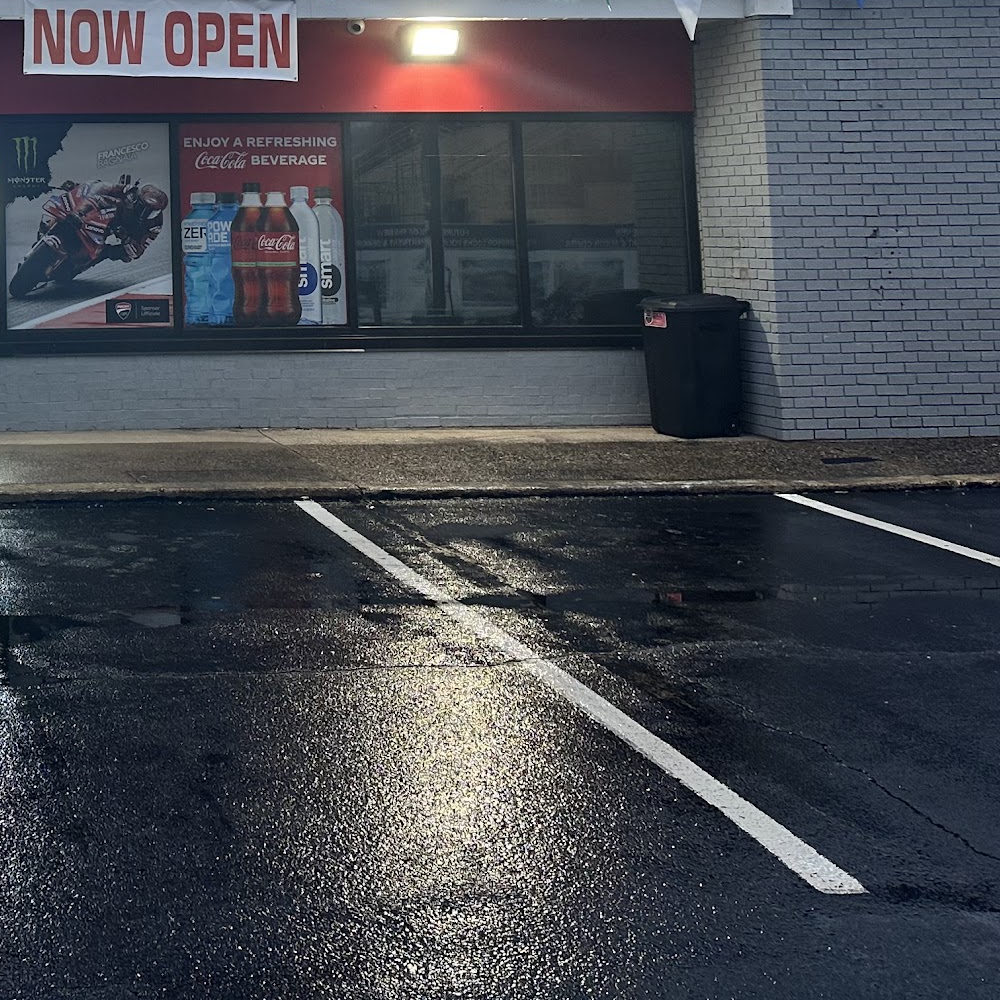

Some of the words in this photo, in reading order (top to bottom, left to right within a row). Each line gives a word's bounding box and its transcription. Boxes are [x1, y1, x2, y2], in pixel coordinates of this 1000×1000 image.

[33, 8, 146, 66] NOW
[164, 10, 291, 69] OPEN
[183, 137, 230, 148] ENJOY
[232, 137, 243, 147] A
[246, 136, 337, 147] REFRESHING
[97, 141, 150, 160] FRANCESCO
[97, 152, 137, 169] BAGNAIA
[194, 151, 249, 170] Coca-Cola
[251, 154, 327, 166] BEVERAGE
[7, 176, 46, 184] MONSTER
[84, 223, 105, 234] Lenovo
[184, 227, 207, 239] ZER
[208, 221, 232, 232] POW
[258, 235, 296, 250] Coca-Cola
[320, 239, 333, 289] smart
